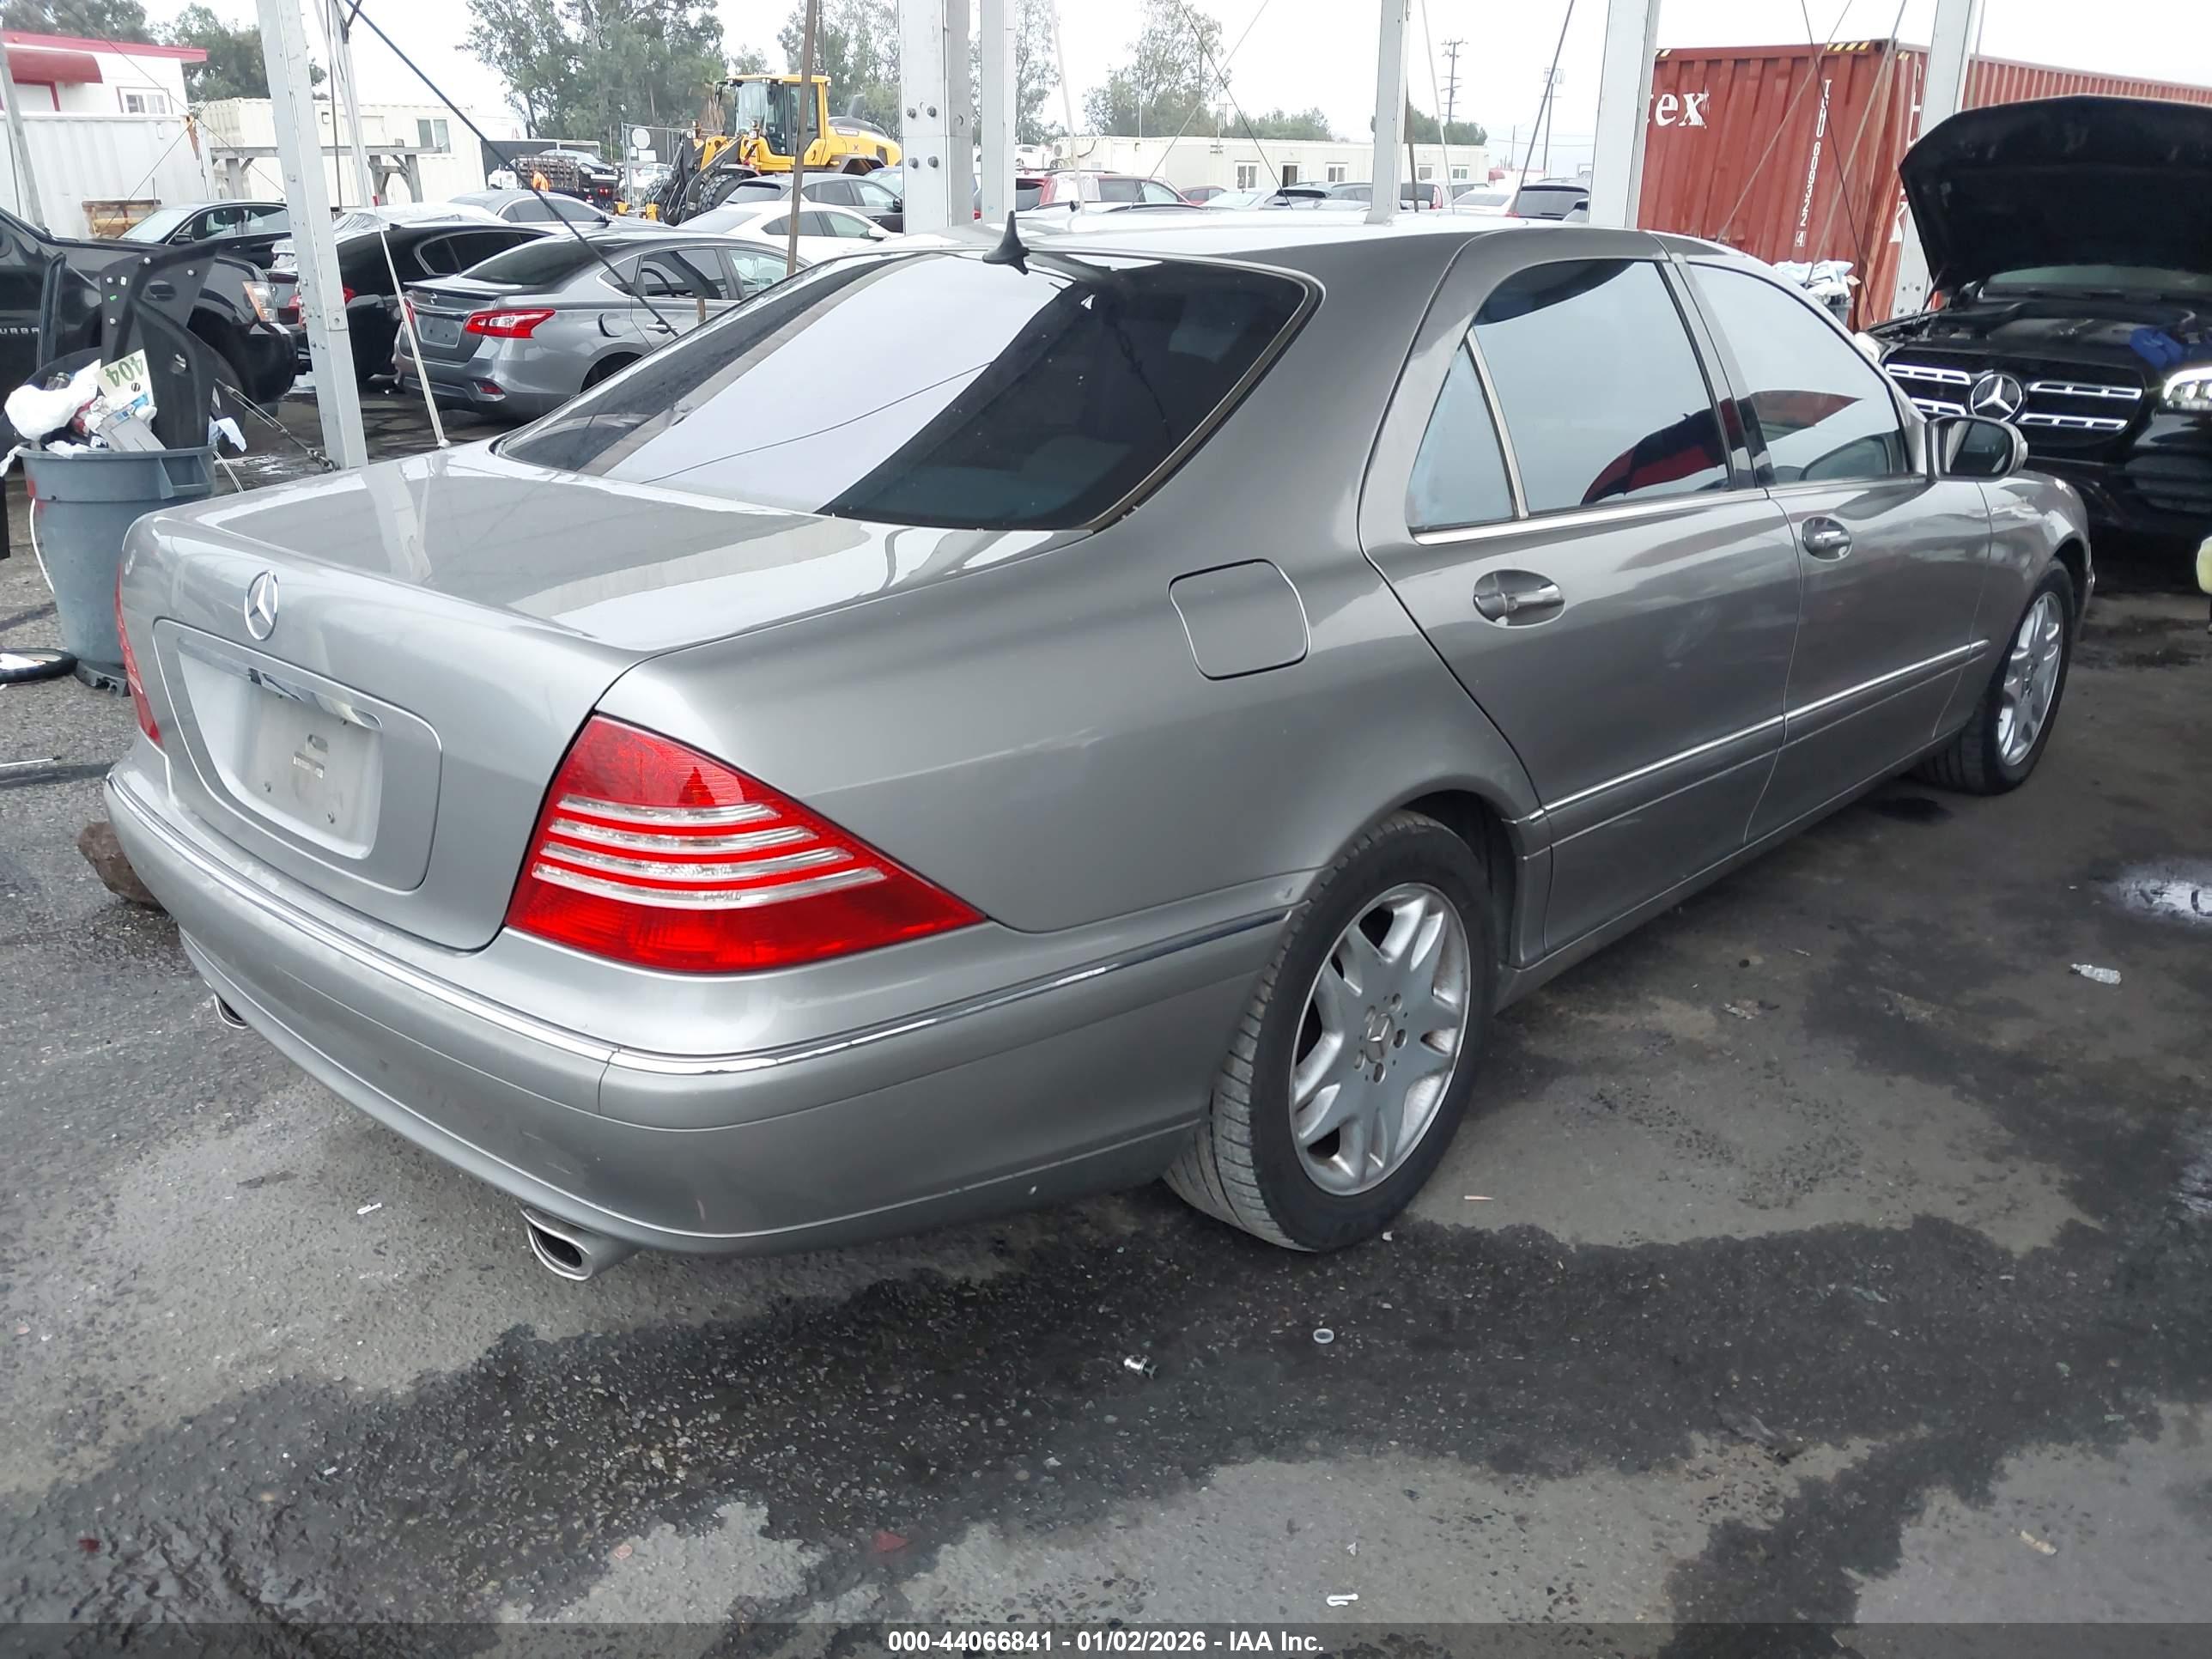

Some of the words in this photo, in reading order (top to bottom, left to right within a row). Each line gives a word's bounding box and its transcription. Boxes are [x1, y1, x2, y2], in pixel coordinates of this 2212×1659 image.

[1799, 141, 1821, 227] 609322
[1796, 231, 1805, 246] 4
[105, 356, 144, 387] 404
